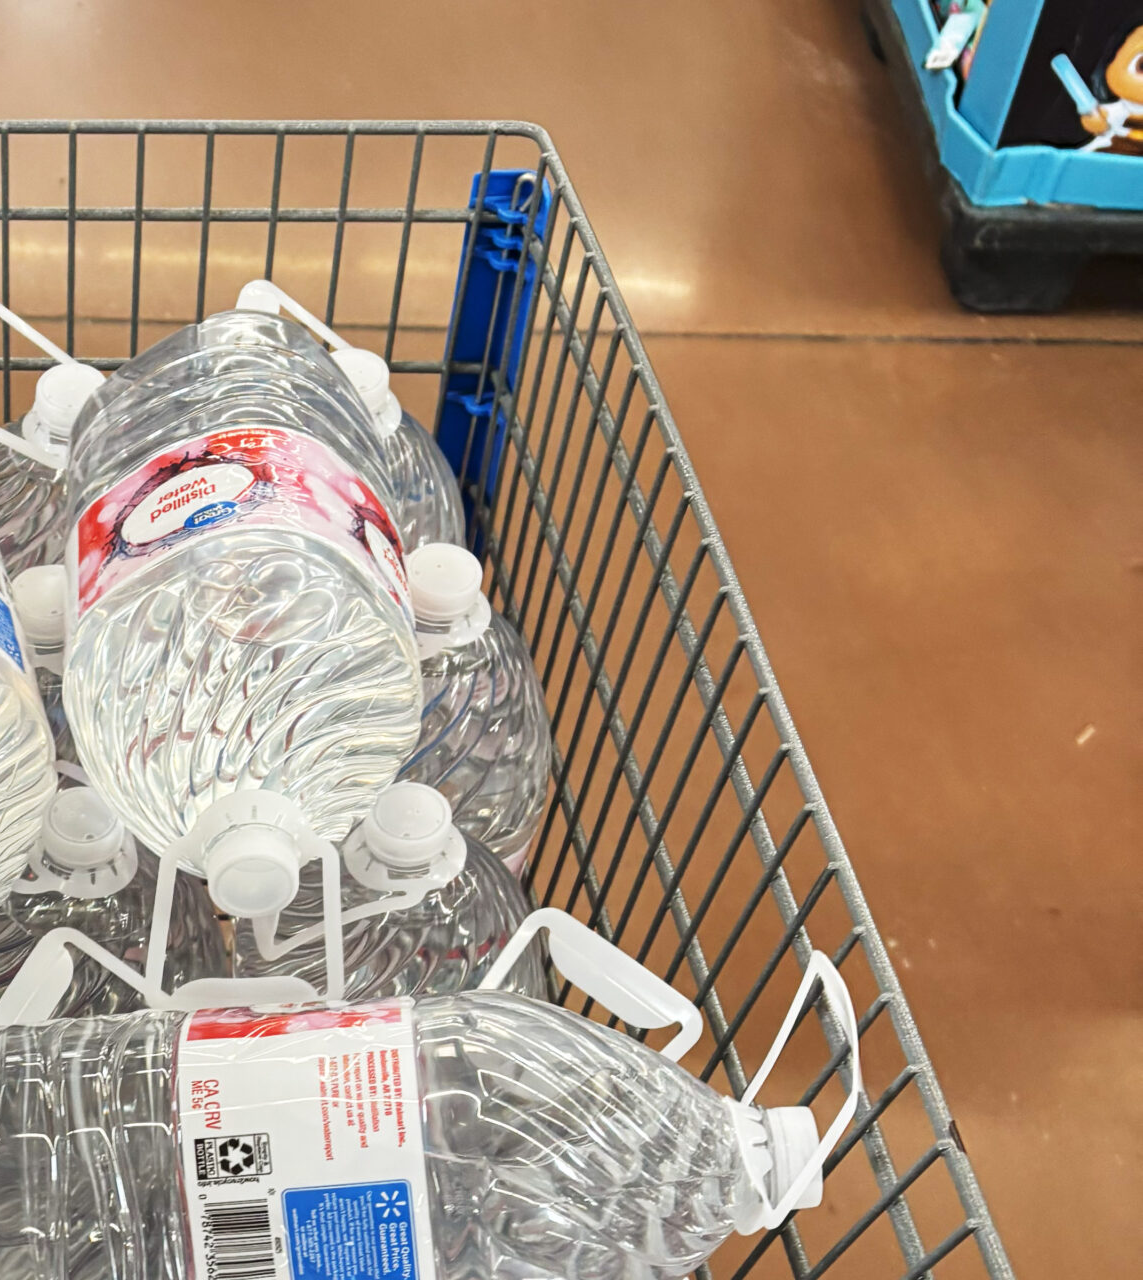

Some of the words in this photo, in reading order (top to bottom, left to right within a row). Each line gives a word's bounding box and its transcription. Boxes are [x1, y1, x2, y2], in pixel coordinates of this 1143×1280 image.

[150, 484, 216, 523] Distilled
[157, 477, 208, 506] Water
[191, 1081, 203, 1095] ME
[203, 1080, 219, 1100] CA
[204, 1101, 221, 1130] CRV
[196, 1143, 206, 1176] BOTTLE
[206, 1141, 215, 1176] PLASTIC
[389, 1222, 398, 1246] Great
[399, 1222, 408, 1245] Great
